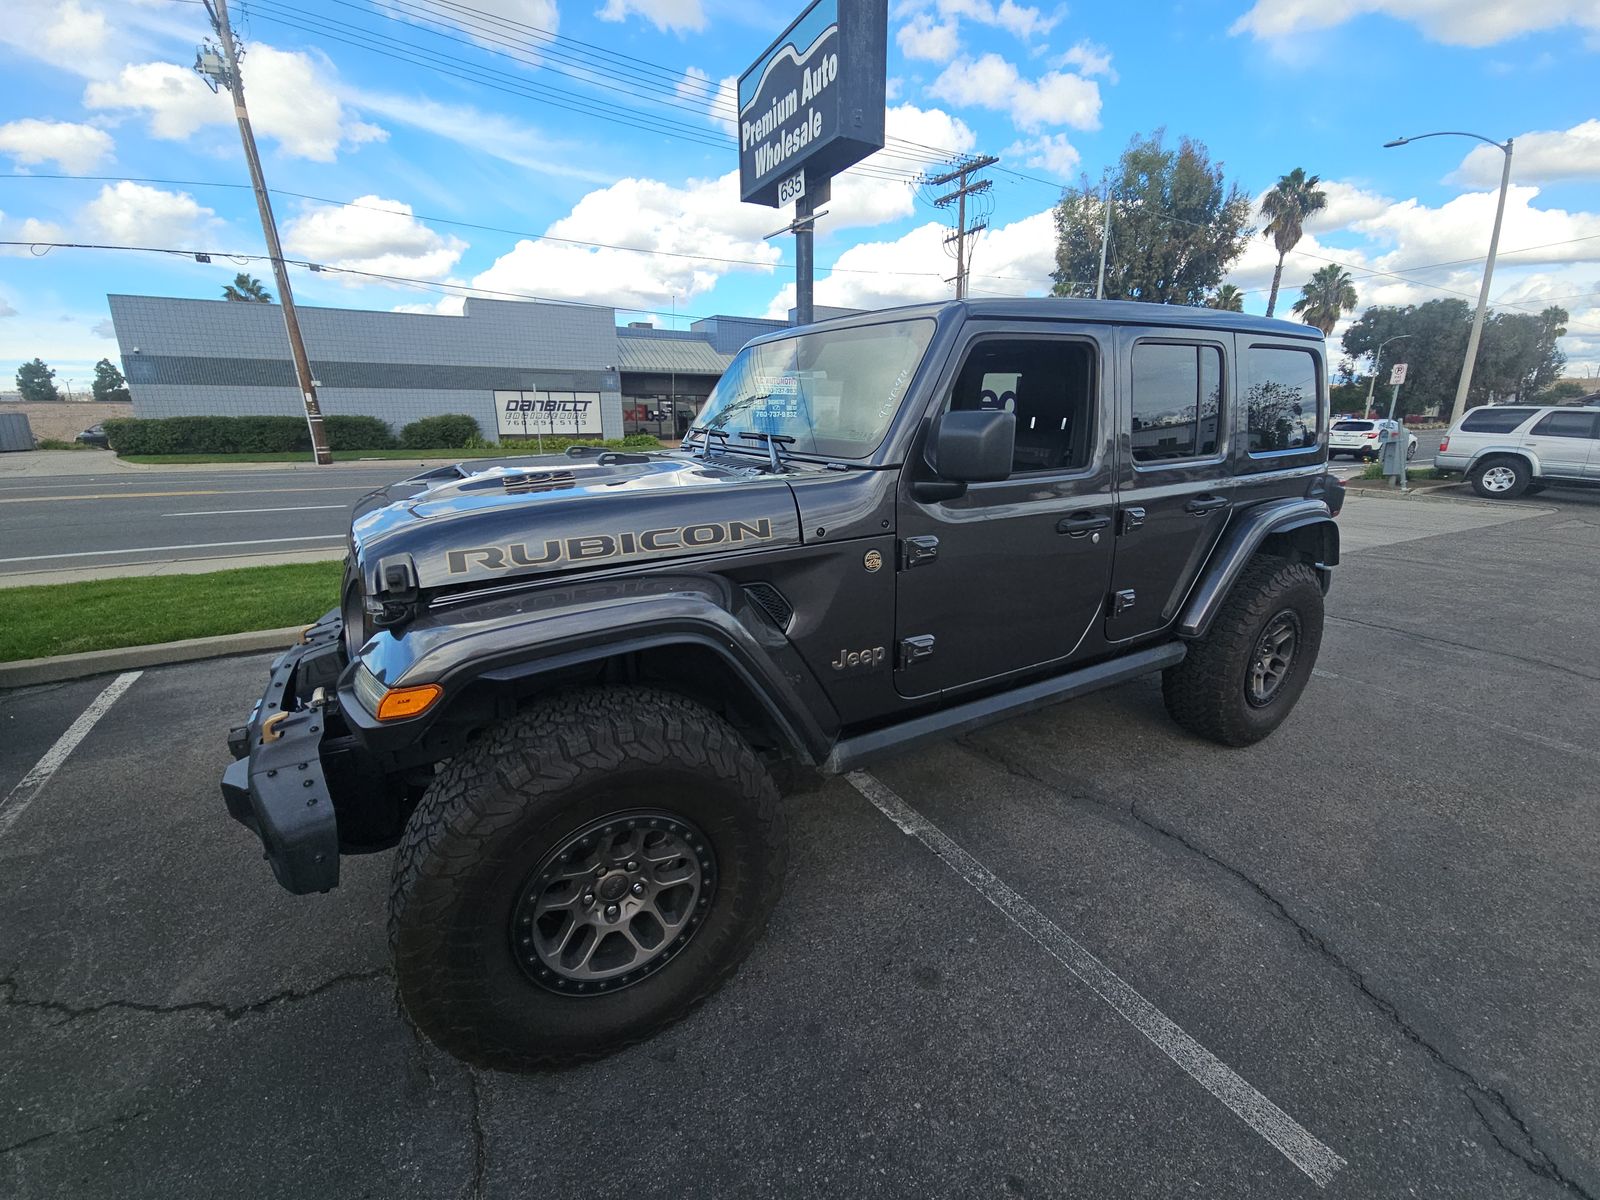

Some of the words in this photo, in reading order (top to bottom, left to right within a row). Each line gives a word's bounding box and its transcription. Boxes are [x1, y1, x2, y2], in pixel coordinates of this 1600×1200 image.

[742, 89, 797, 152] Premium
[801, 53, 838, 106] Auto
[755, 108, 822, 179] Wholesale
[781, 175, 802, 202] 635
[447, 517, 773, 575] RUBICON
[831, 646, 887, 671] Jeep
